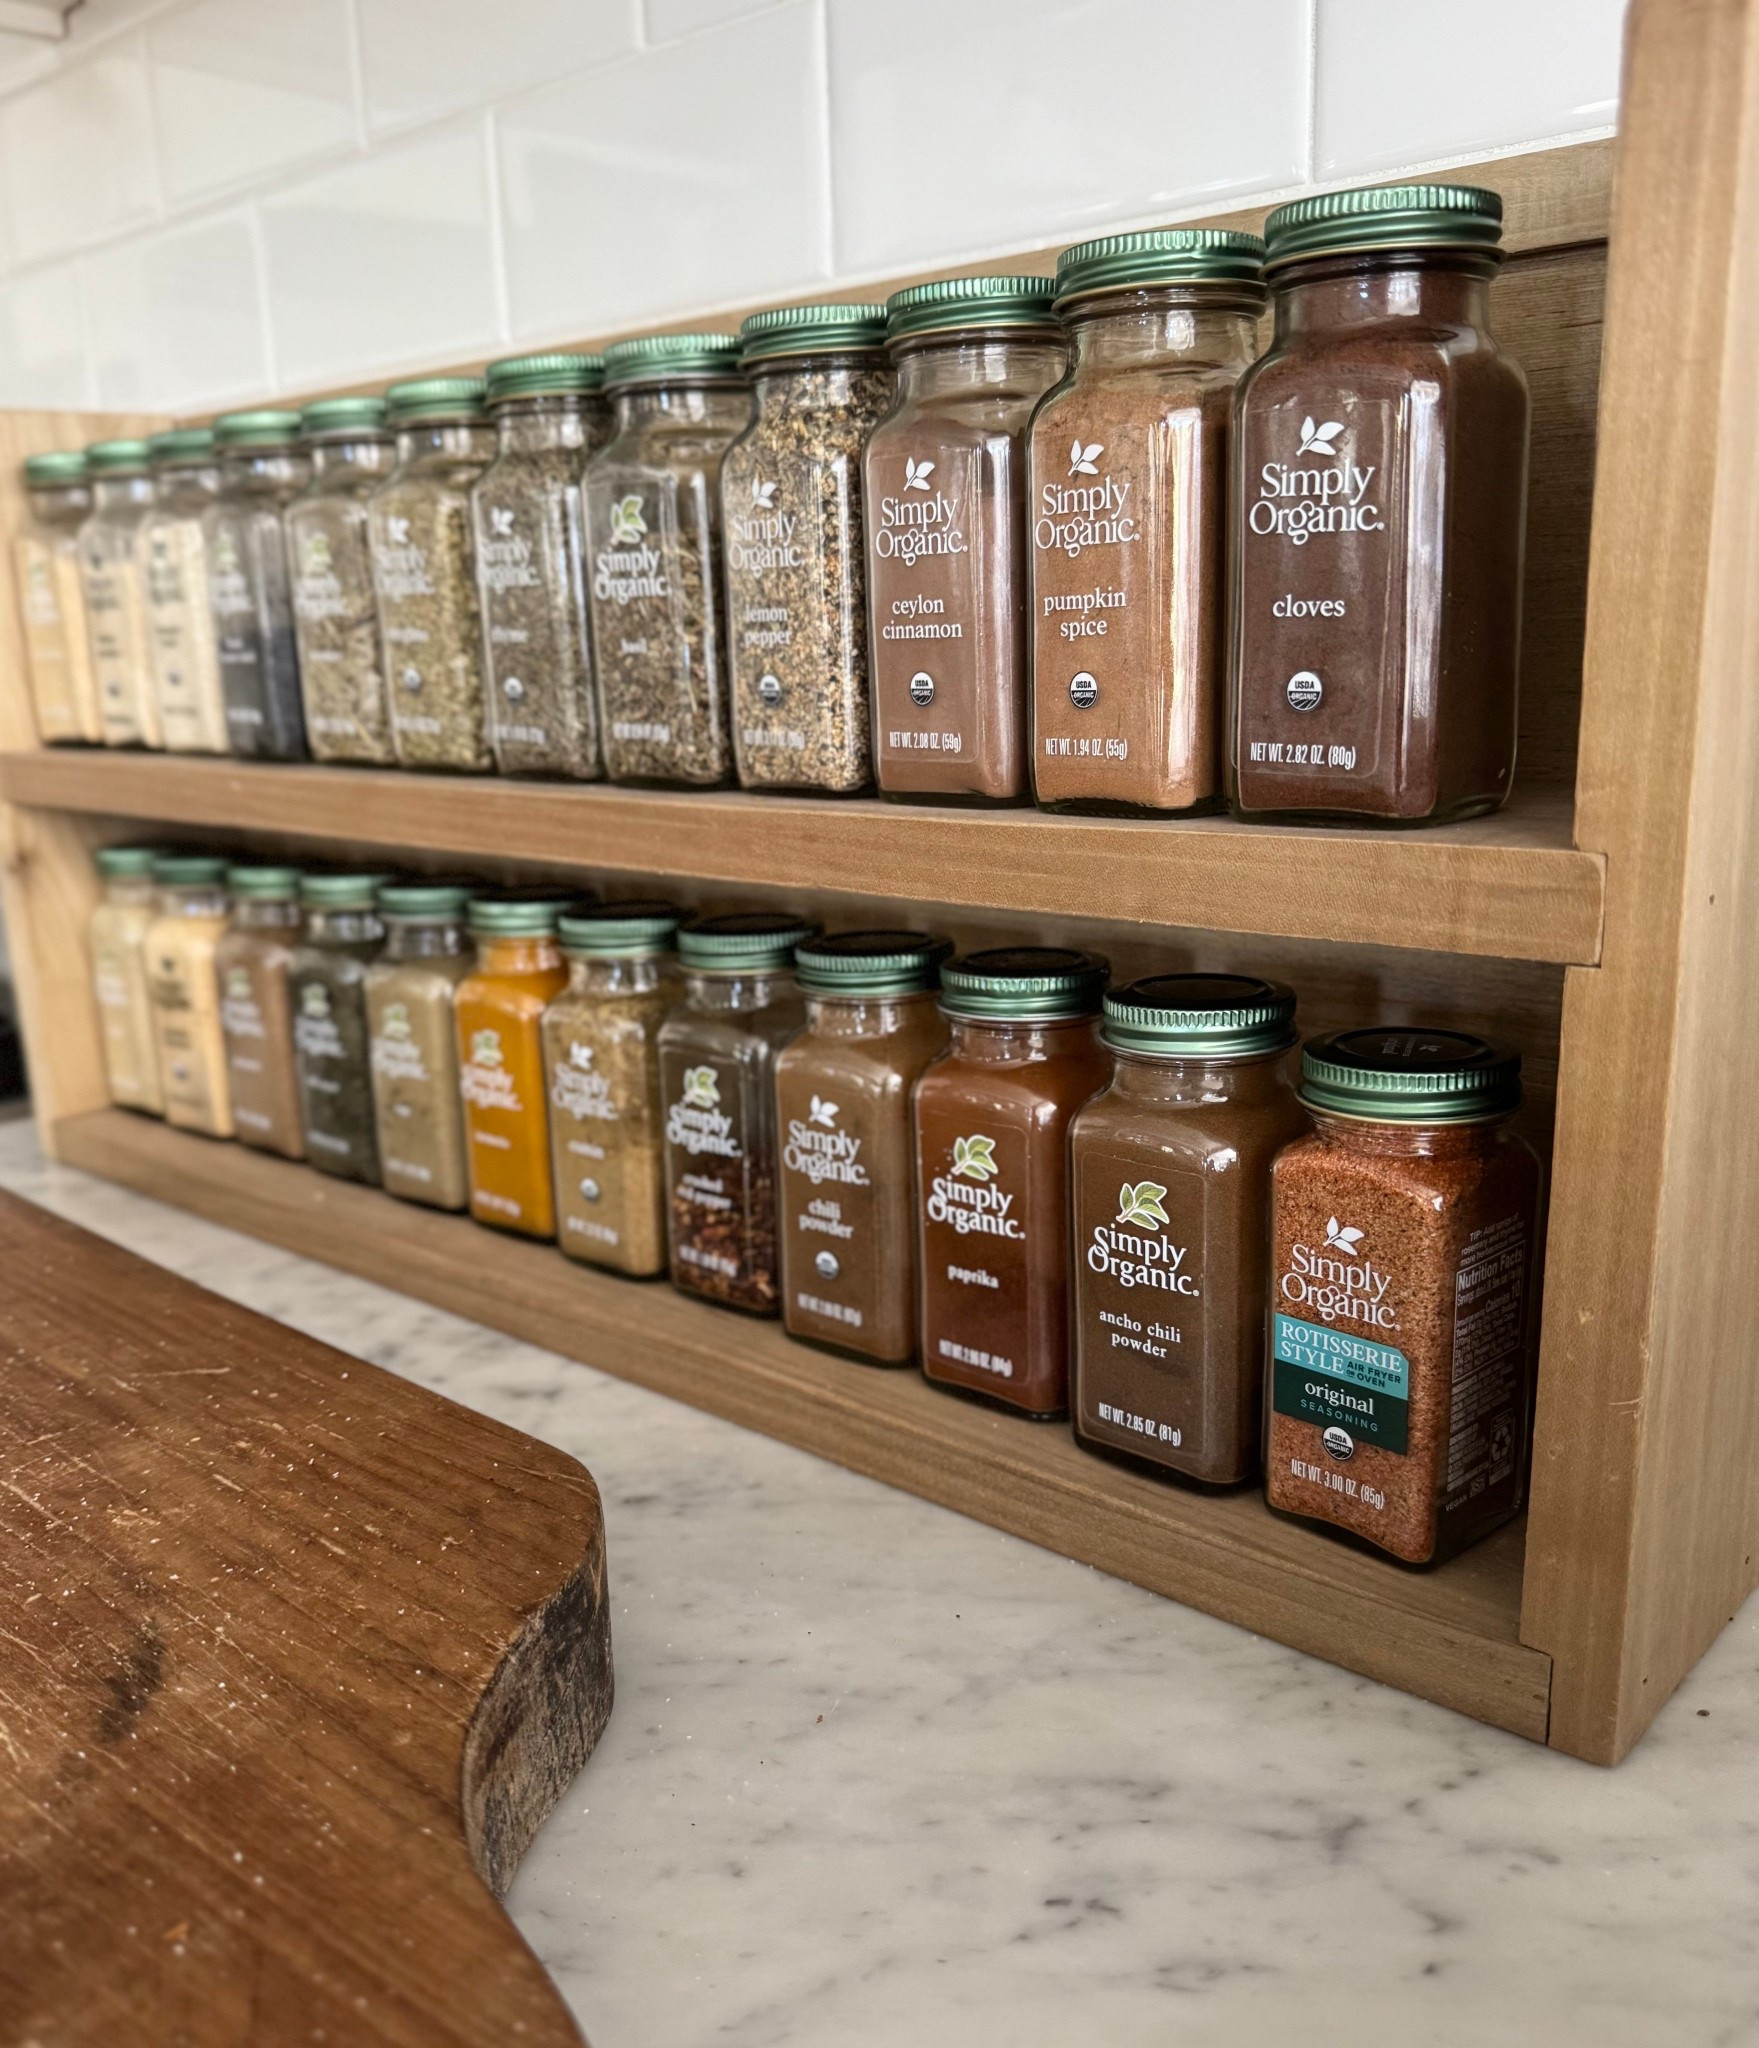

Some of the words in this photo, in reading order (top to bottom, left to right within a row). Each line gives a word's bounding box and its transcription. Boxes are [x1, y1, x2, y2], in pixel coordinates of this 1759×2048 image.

[1260, 458, 1376, 505] Simply
[1042, 475, 1131, 520] Simply
[882, 490, 958, 532] Simply
[733, 510, 797, 547] Simply
[597, 543, 660, 577] Simply
[744, 604, 787, 622] lemon
[892, 594, 944, 618] ceylon
[1043, 586, 1127, 616] pumpkin
[1272, 594, 1346, 617] cloves
[742, 629, 792, 648] pepper
[882, 621, 963, 640] cinnamon
[1060, 616, 1108, 641] spice
[914, 679, 929, 687] USDA
[1075, 680, 1092, 689] USDA
[1291, 692, 1317, 700] ORGANIC
[1294, 680, 1315, 690] USDA
[889, 731, 901, 748] NET
[901, 732, 912, 749] WT.
[913, 732, 929, 749] 2.08
[930, 732, 941, 749] OZ.
[942, 732, 962, 753] (59g)
[1045, 738, 1058, 755] NET
[1058, 738, 1072, 756] WT.
[1073, 738, 1089, 756] 1.94
[1091, 738, 1103, 757] OZ.
[1105, 738, 1128, 761] (55g)
[1250, 742, 1267, 761] NET
[1268, 743, 1284, 763] WT.
[1286, 744, 1308, 764] 2.82
[1310, 745, 1325, 764] OZ.
[1328, 745, 1356, 770] (80g)
[788, 1119, 861, 1165] Simply
[932, 1174, 1014, 1216] Simply
[808, 1198, 841, 1220] chili
[799, 1214, 854, 1239] powder
[1094, 1223, 1187, 1271] Simply
[947, 1264, 999, 1289] paprika
[1291, 1243, 1392, 1303] Simply
[1458, 1261, 1498, 1292] Nutrition
[1099, 1310, 1142, 1332] ancho
[1147, 1322, 1181, 1343] chili
[1111, 1333, 1167, 1358] powder
[1281, 1321, 1402, 1373] ROTISSERIE
[1281, 1340, 1344, 1374] STYLE
[1347, 1361, 1364, 1373] AIR
[1368, 1366, 1401, 1384] FRYER
[1357, 1372, 1385, 1388] OVEN
[1304, 1382, 1374, 1416] original
[1099, 1402, 1112, 1420] NET
[1126, 1413, 1144, 1433] 2.85
[1145, 1419, 1157, 1437] OZ.
[1159, 1424, 1181, 1447] (81g)
[1301, 1399, 1378, 1432] SEASONING
[1329, 1432, 1347, 1444] USDA
[1291, 1458, 1306, 1478] NET
[1308, 1464, 1322, 1484] WT.
[1324, 1470, 1342, 1492] 3.00
[1345, 1478, 1359, 1498] OZ.
[1361, 1484, 1384, 1509] (85g)
